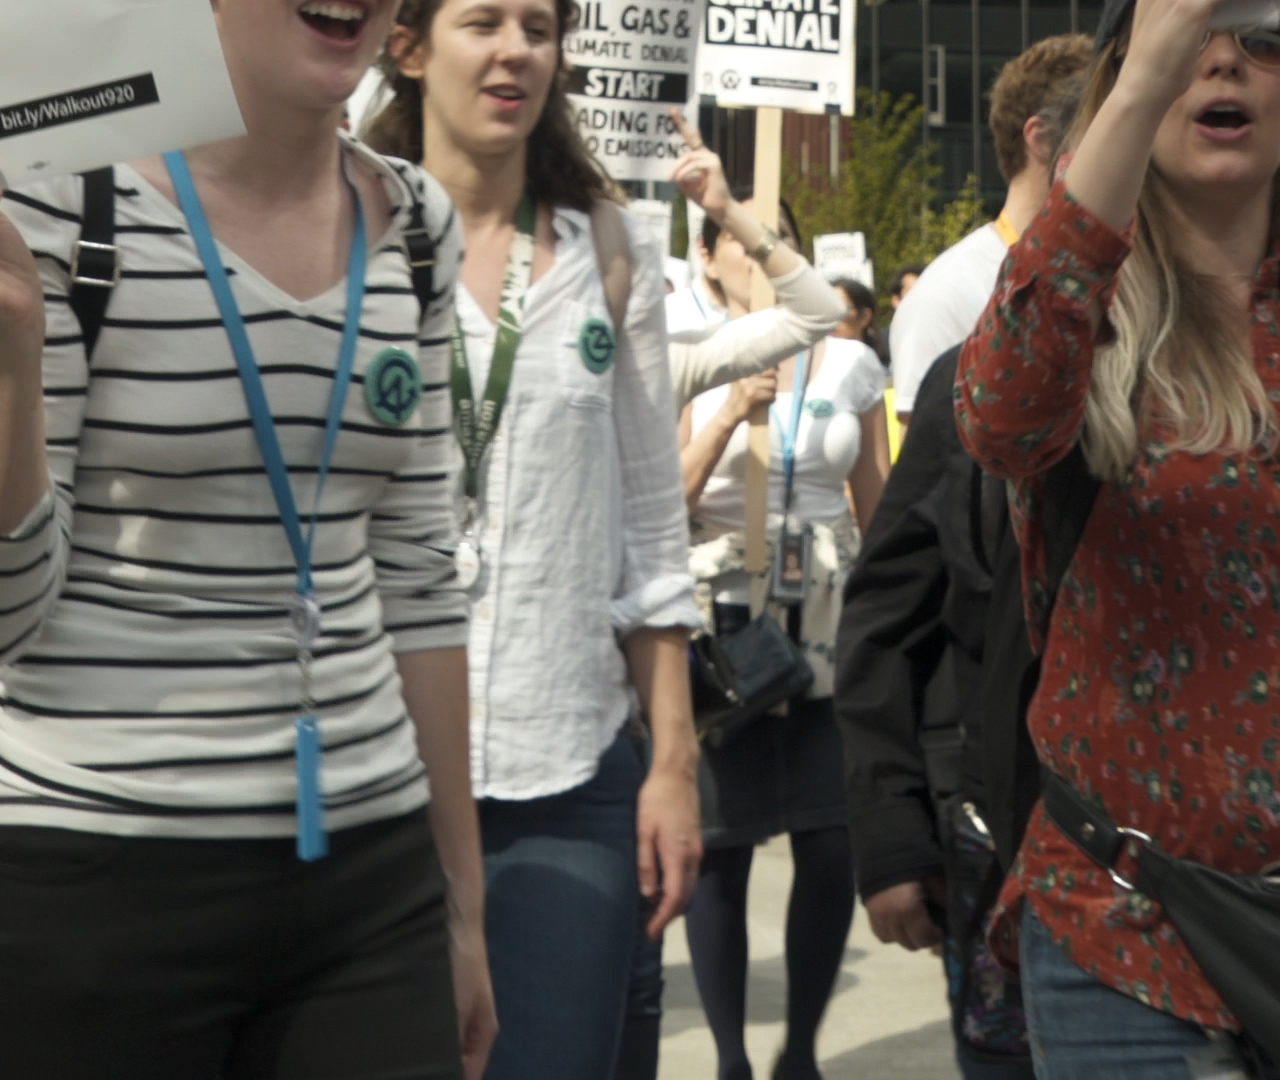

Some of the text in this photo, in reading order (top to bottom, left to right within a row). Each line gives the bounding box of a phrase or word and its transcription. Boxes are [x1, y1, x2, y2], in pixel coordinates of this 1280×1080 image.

[621, 4, 669, 35] GAS
[673, 9, 690, 39] &
[707, 5, 840, 52] DENIAL
[565, 37, 688, 63] LIMATE DENIAL
[584, 68, 665, 100] START
[0, 83, 135, 131] bit.ly/Walkout920
[577, 108, 686, 135] ADING FO
